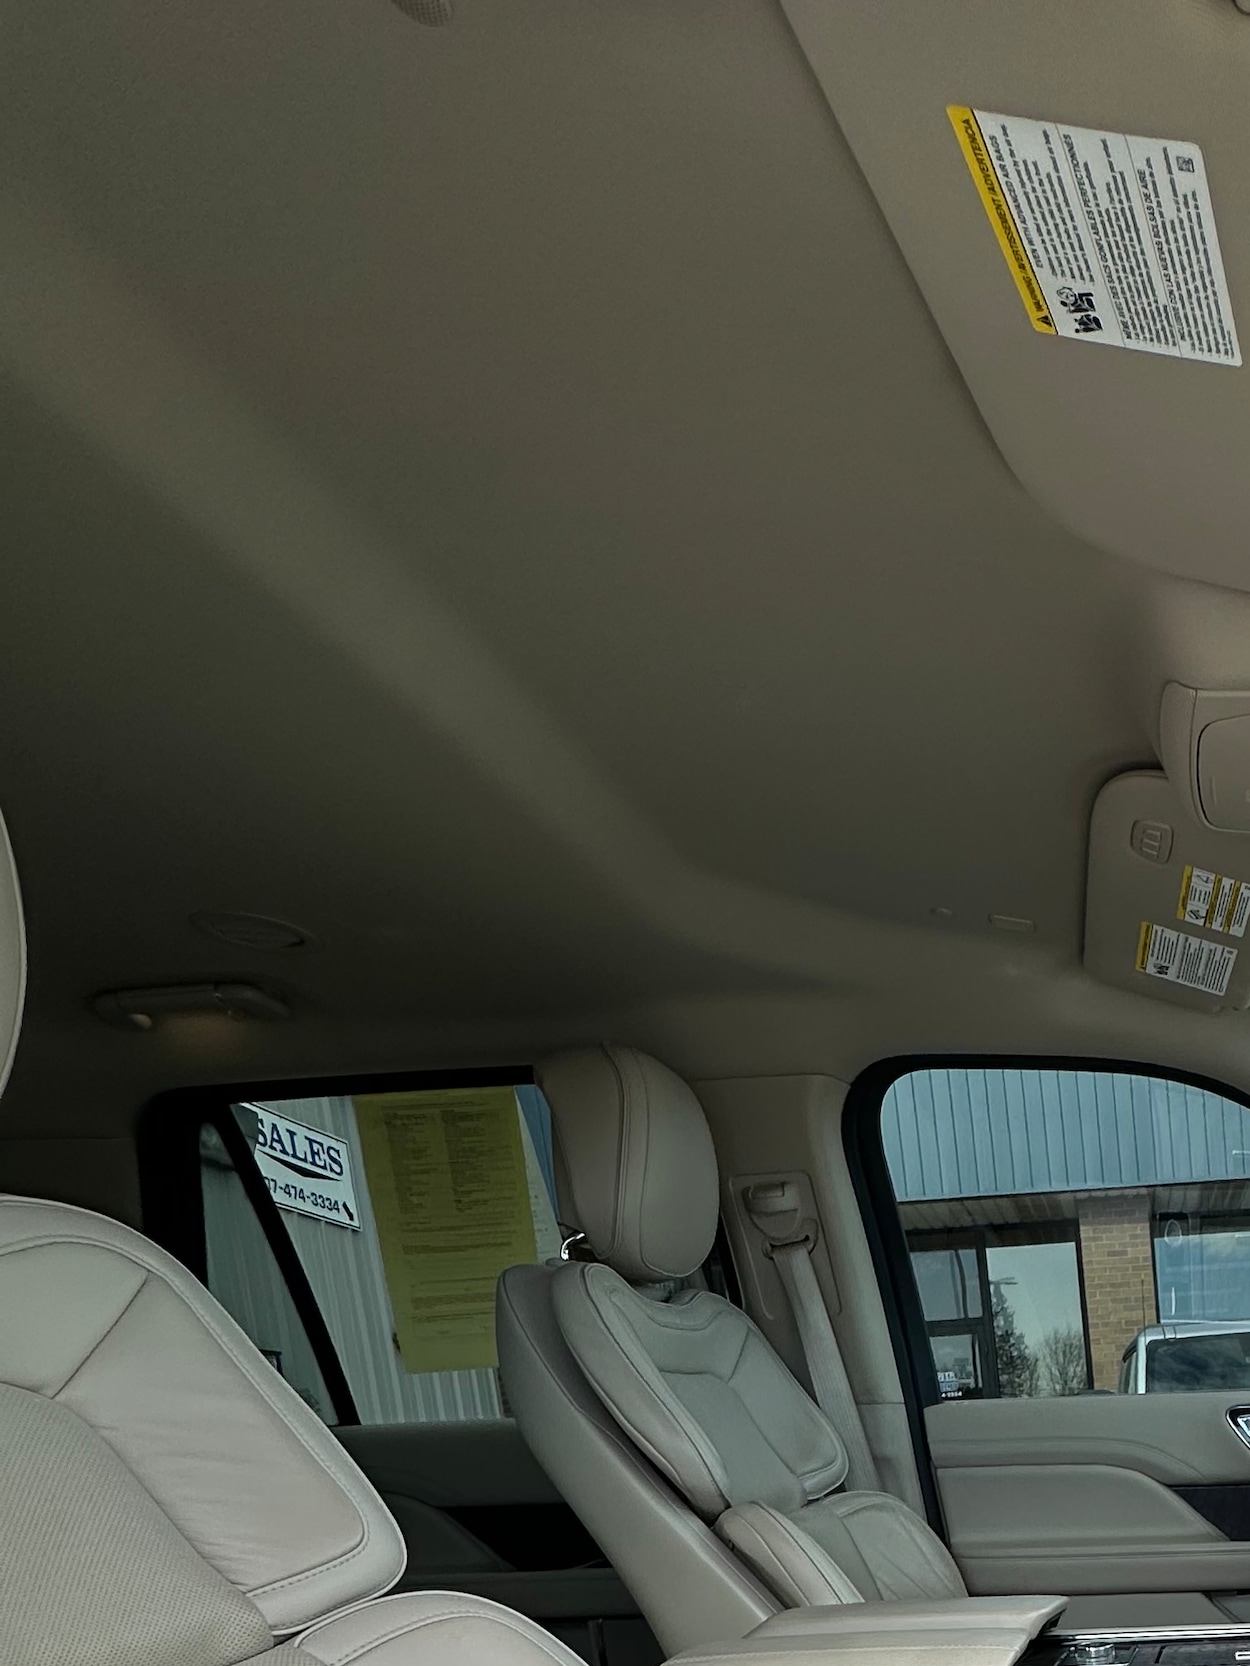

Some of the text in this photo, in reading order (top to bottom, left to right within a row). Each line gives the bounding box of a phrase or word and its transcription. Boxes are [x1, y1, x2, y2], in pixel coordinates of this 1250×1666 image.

[987, 134, 1005, 162] BAGS
[998, 162, 1012, 179] AIR
[1004, 180, 1028, 225] ADVANCED
[257, 1118, 344, 1177] SALES
